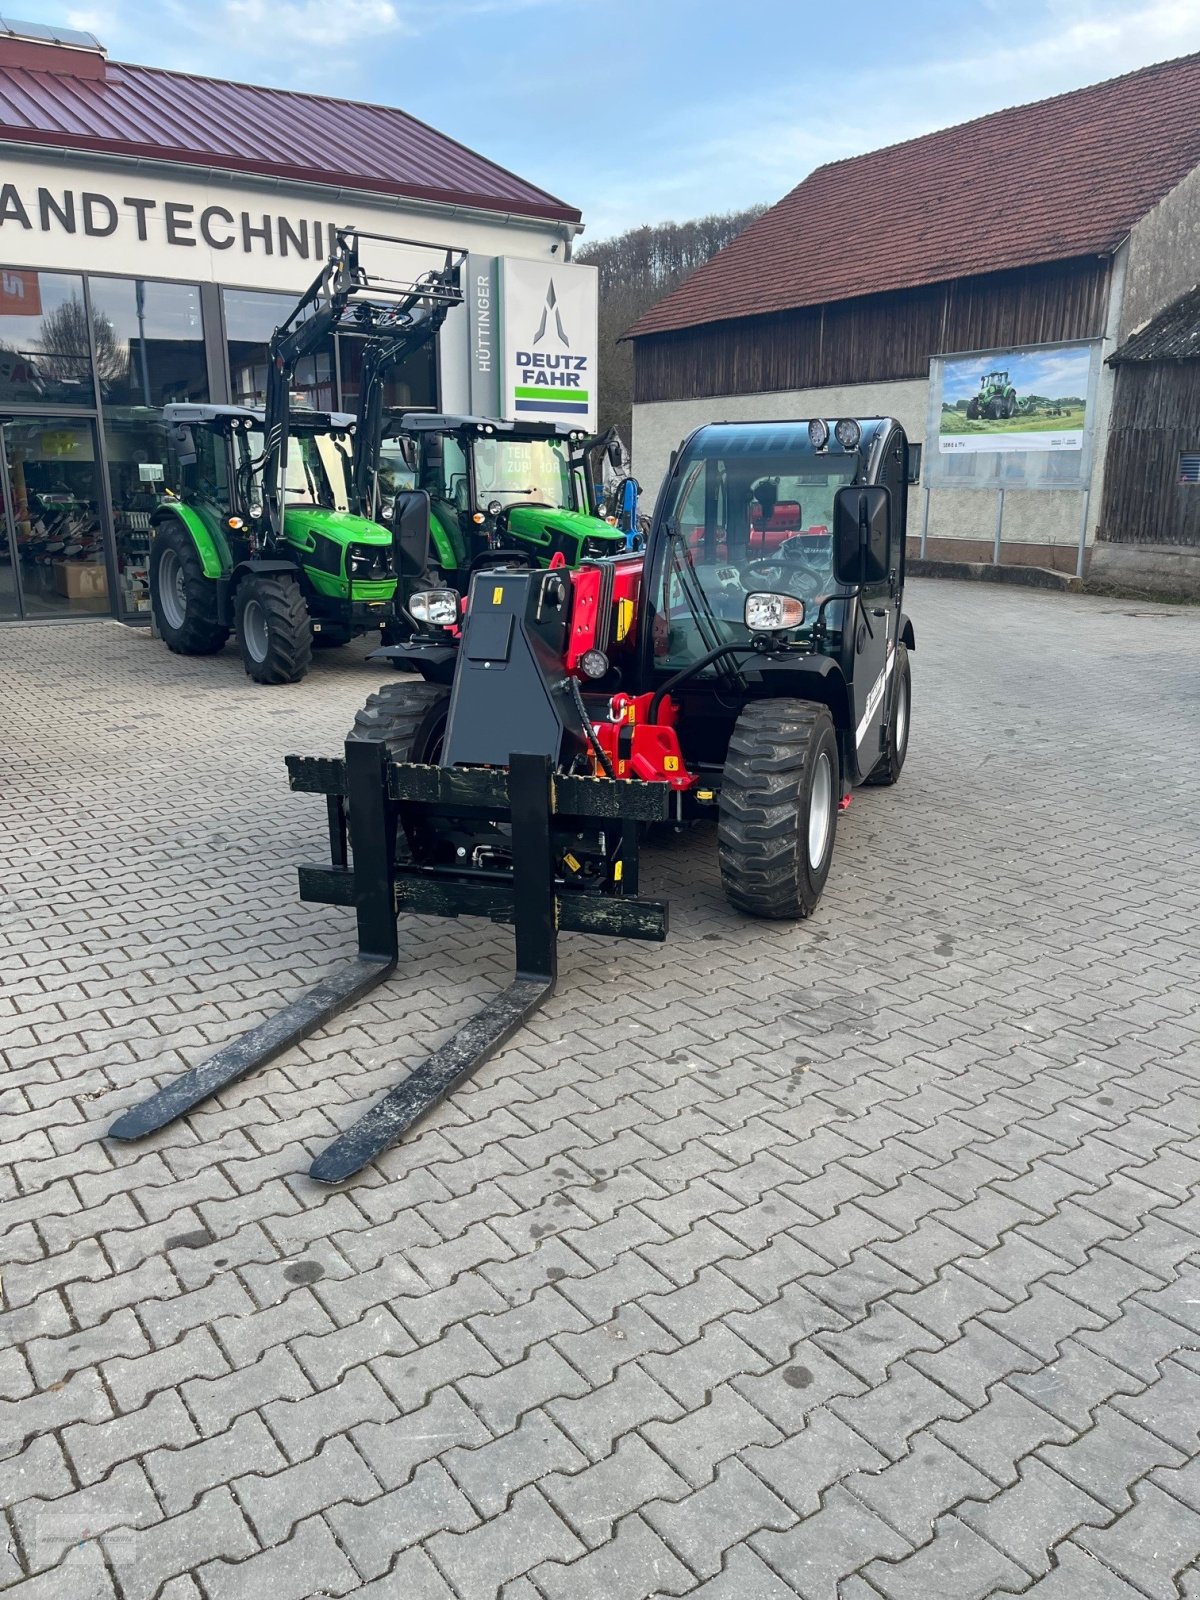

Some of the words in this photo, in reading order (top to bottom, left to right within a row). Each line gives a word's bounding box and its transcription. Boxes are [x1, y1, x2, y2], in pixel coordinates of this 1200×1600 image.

[475, 275, 491, 372] HÜTTINGER
[515, 351, 588, 371] DEUTZ
[522, 369, 580, 387] FAHR
